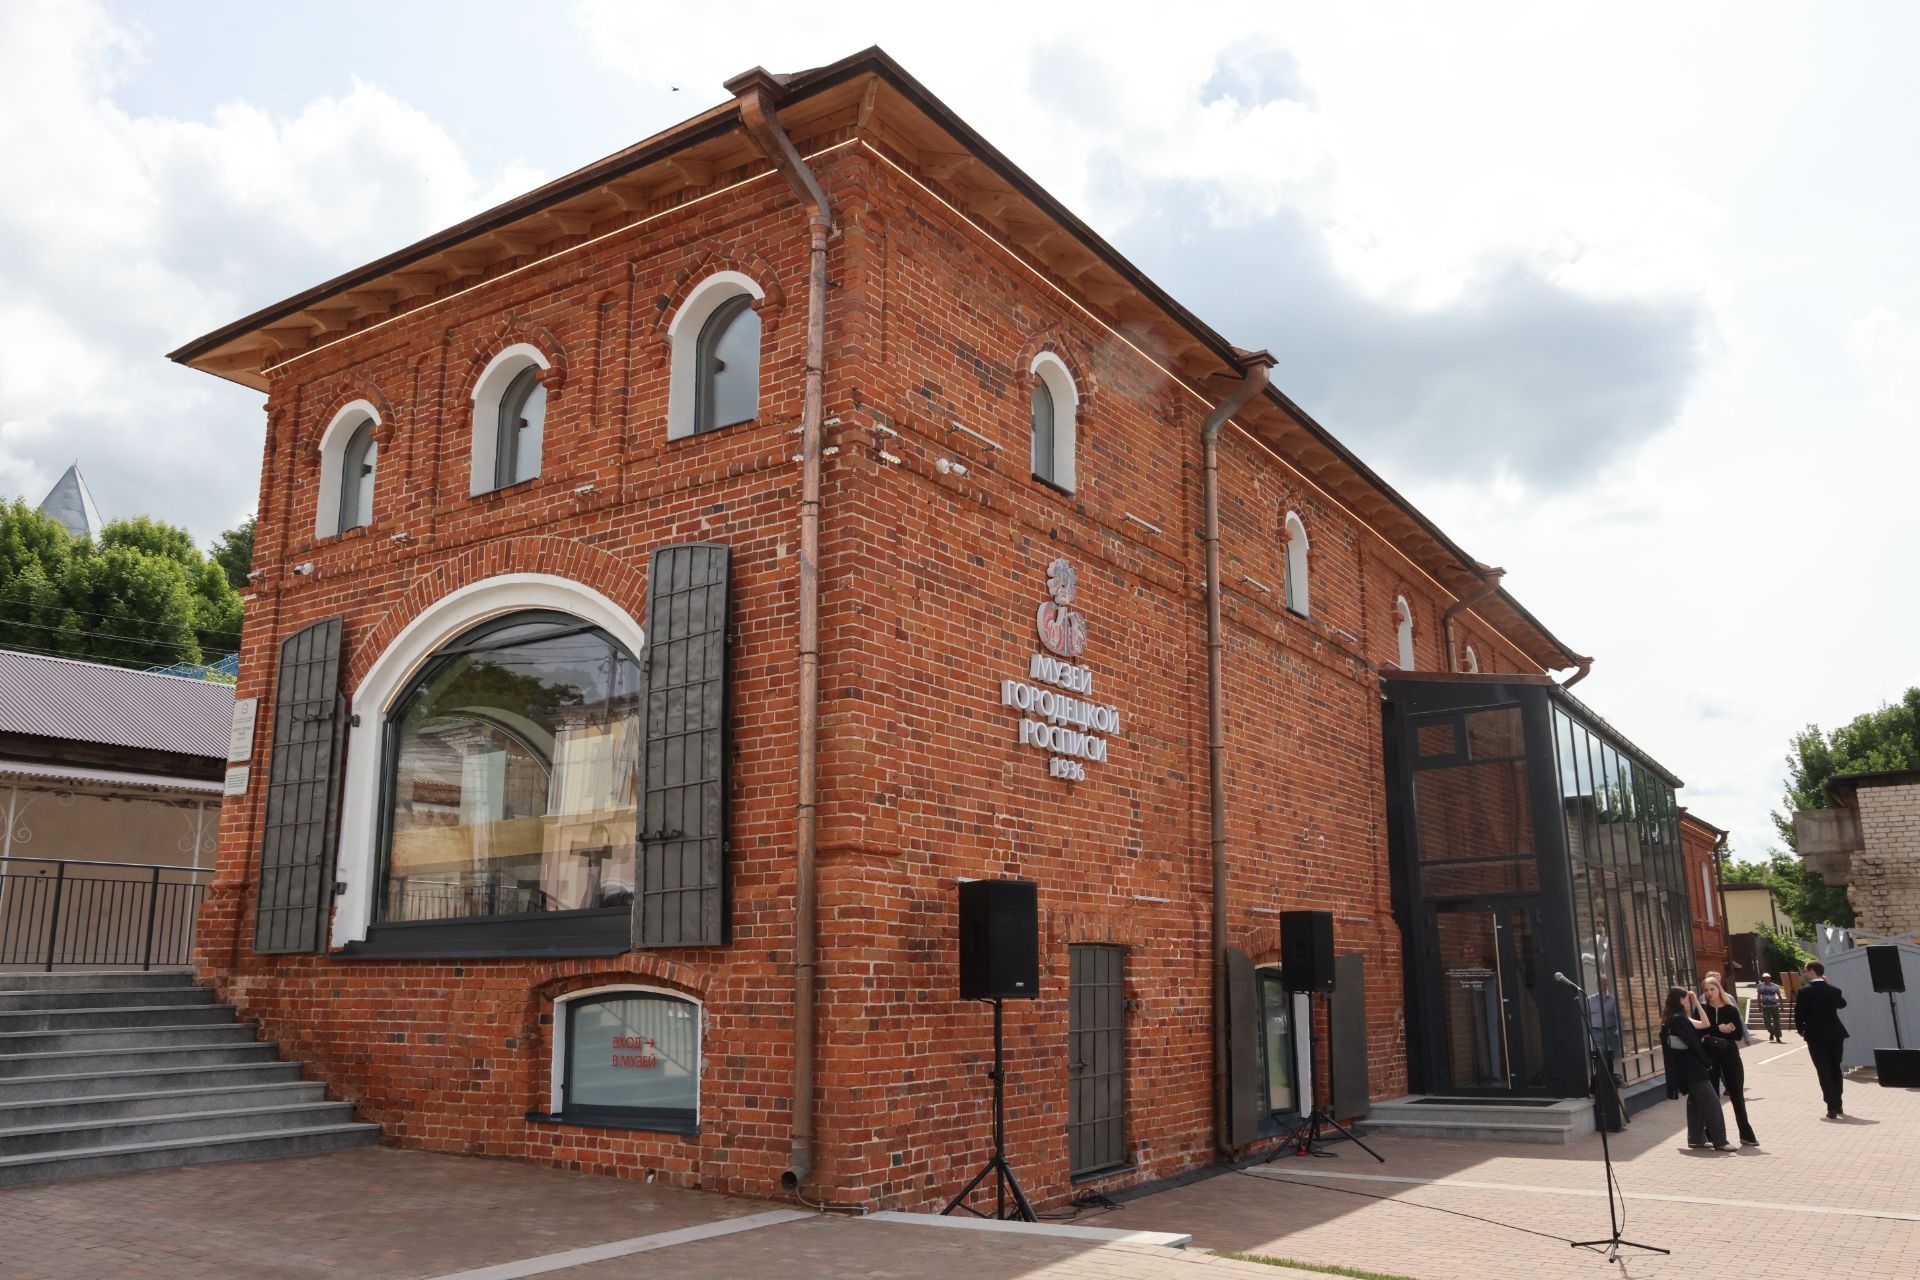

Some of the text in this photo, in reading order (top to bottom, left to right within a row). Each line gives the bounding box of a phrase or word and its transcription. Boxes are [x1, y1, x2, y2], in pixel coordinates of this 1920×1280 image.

[1030, 654, 1092, 695] МУЗЕЙ
[1001, 680, 1119, 734] ГОРОДЕЦКОЙ
[1019, 718, 1107, 762] РОСПИСИ
[1049, 757, 1084, 781] 1936
[612, 1036, 642, 1050] ВХОД
[612, 1053, 656, 1068] В МУЗЕЙ
